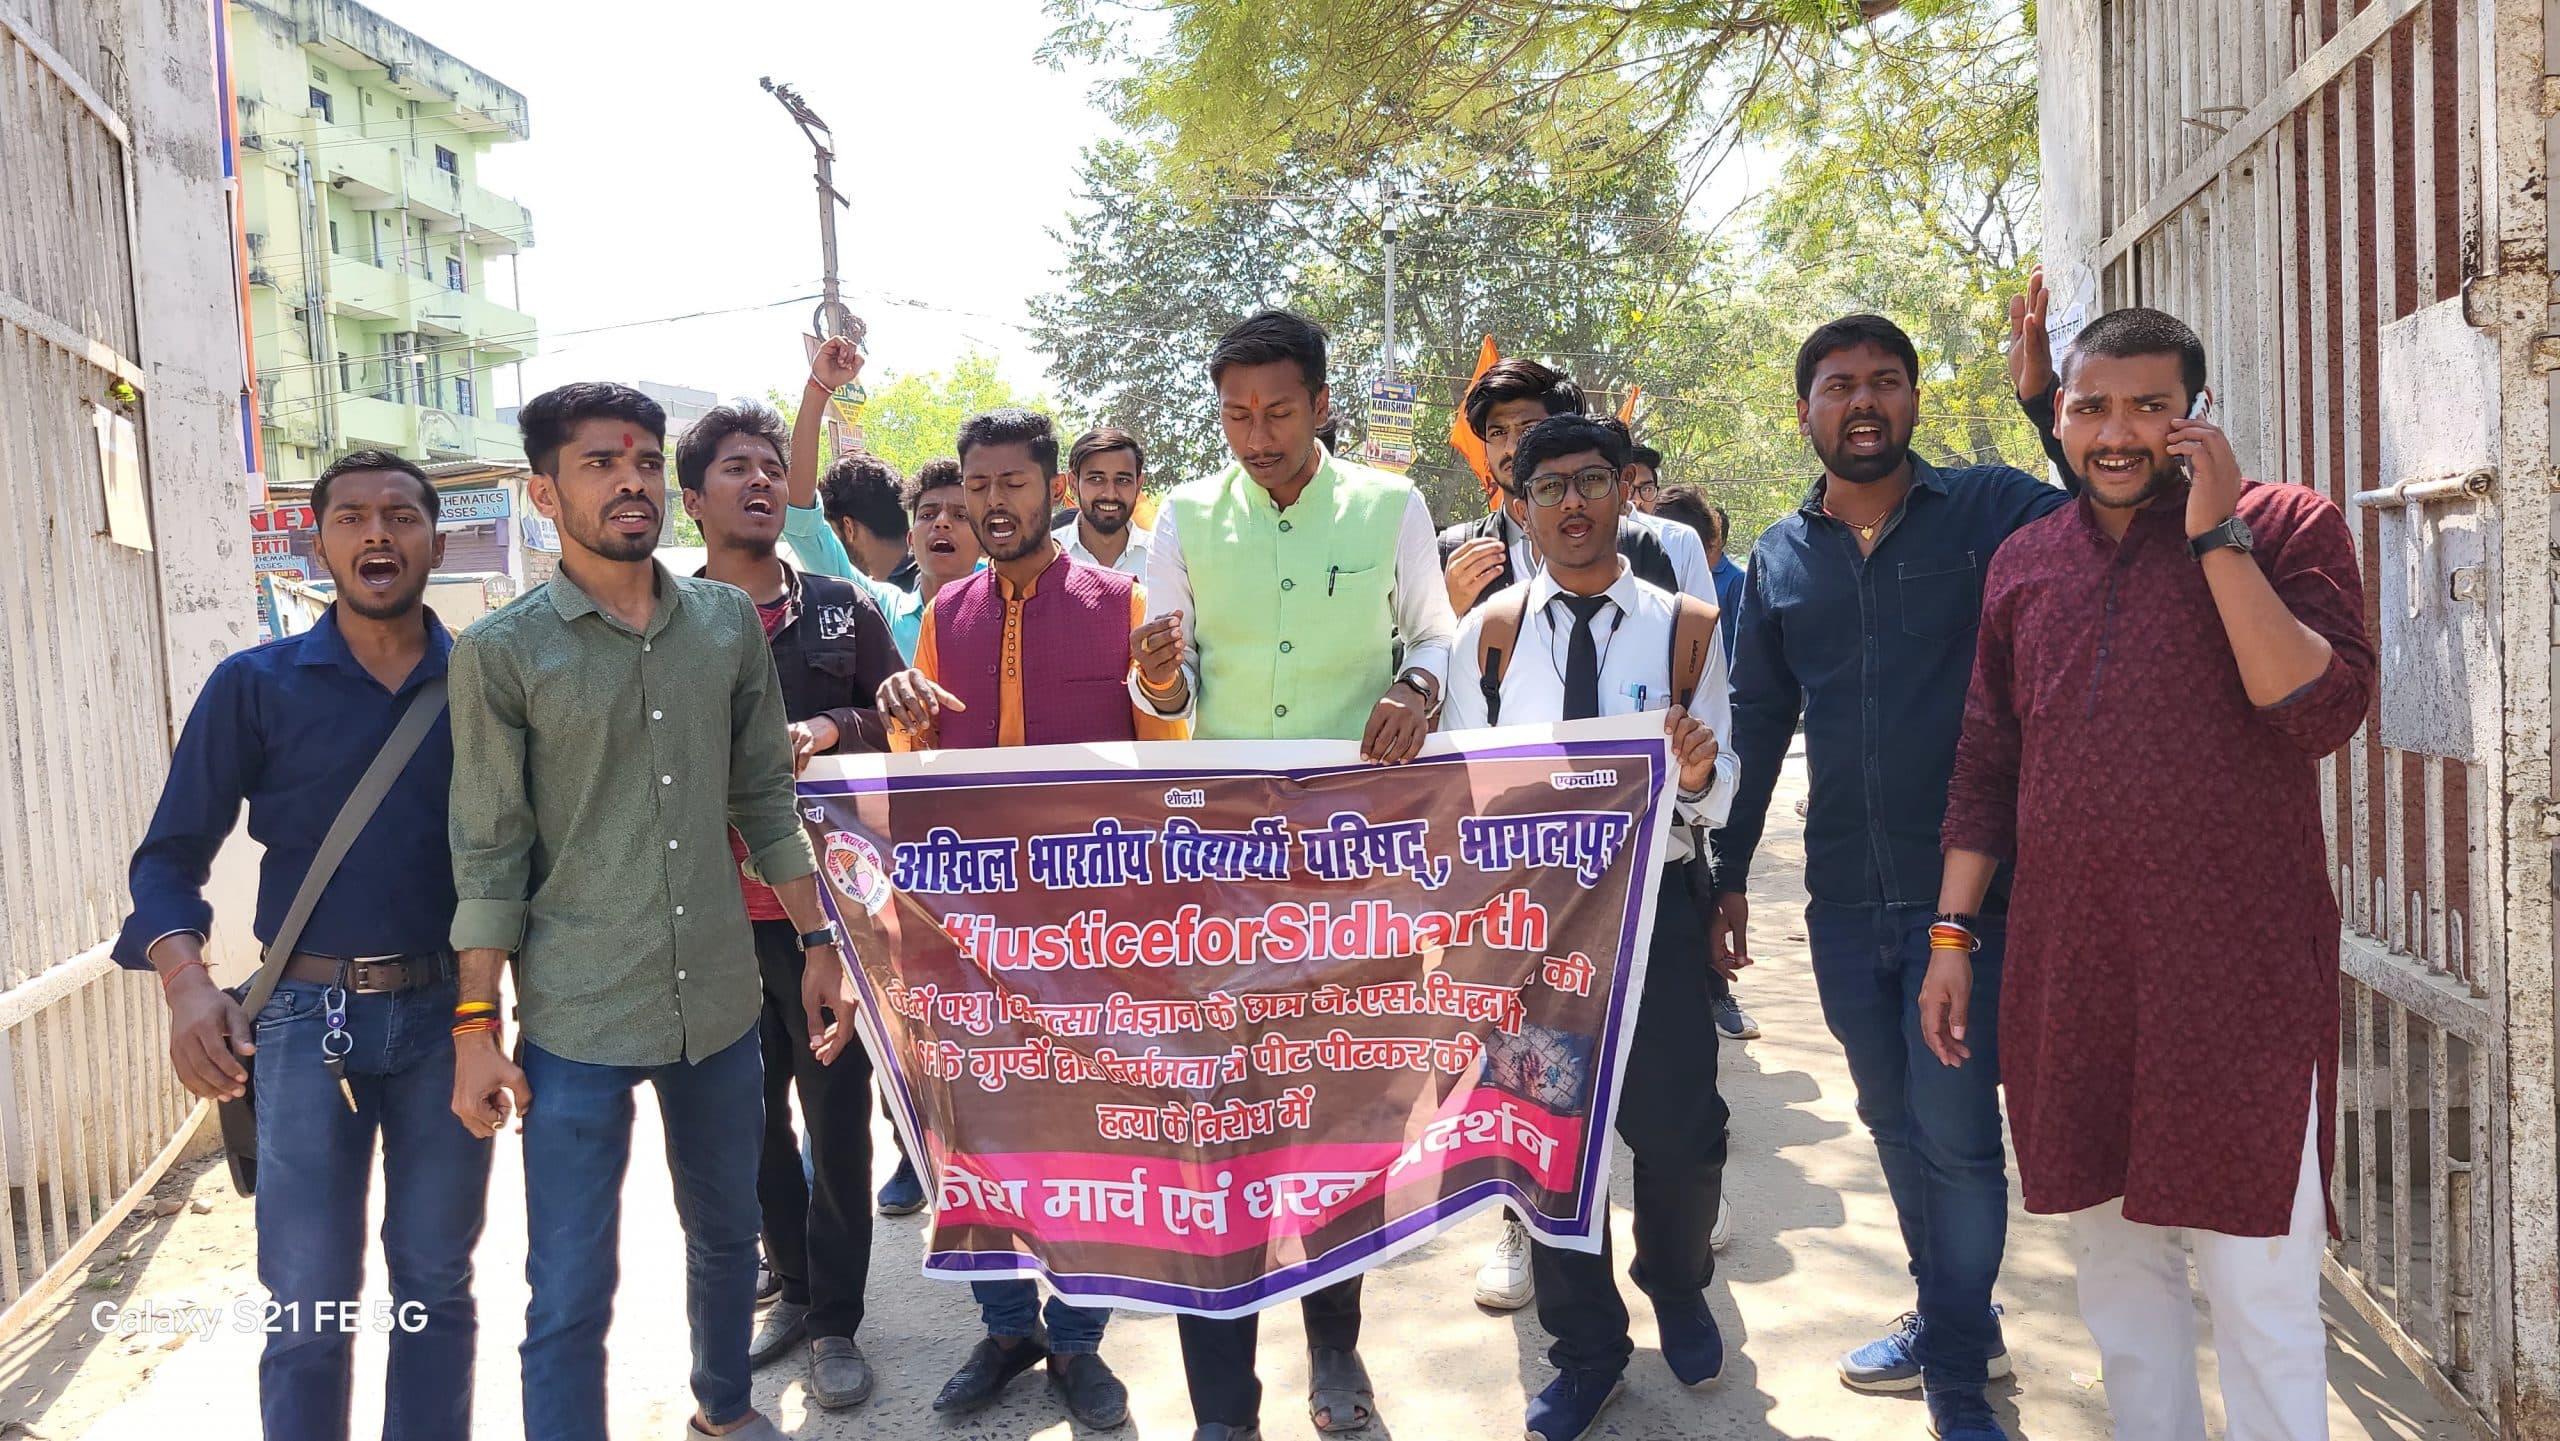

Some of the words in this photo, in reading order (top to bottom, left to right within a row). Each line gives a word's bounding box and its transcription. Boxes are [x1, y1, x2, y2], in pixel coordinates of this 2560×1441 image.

[1371, 413, 1394, 425] CONVENT
[1394, 415, 1412, 428] SCHOOL
[1372, 400, 1413, 414] KARISHMA
[1165, 789, 1205, 808] शील!!
[1550, 769, 1617, 790] एकता!!!
[891, 827, 1018, 893] अखिल
[1029, 816, 1154, 888] भारतीय
[1161, 815, 1290, 883] विद्यार्थी
[1457, 810, 1633, 889] भागलपुर
[940, 889, 1548, 977] #justiceforSidharth
[937, 991, 994, 1035] पशु
[1105, 991, 1203, 1037] विज्ञान
[1200, 990, 1237, 1031] के
[1240, 992, 1308, 1024] छात्र
[1543, 951, 1596, 997] की
[970, 1035, 1053, 1092] गुण्डों
[1095, 1047, 1221, 1089] निर्ममता
[1252, 1031, 1315, 1076] पीट
[1316, 1028, 1434, 1073] पीटकर
[1434, 1031, 1484, 1075] की
[1096, 1104, 1159, 1141] हत्या
[1160, 1101, 1189, 1144] के
[1191, 1098, 1275, 1148] विरोध
[1277, 1085, 1317, 1129] में
[1042, 1167, 1148, 1227] मार्च
[1158, 1170, 1234, 1236] एवं
